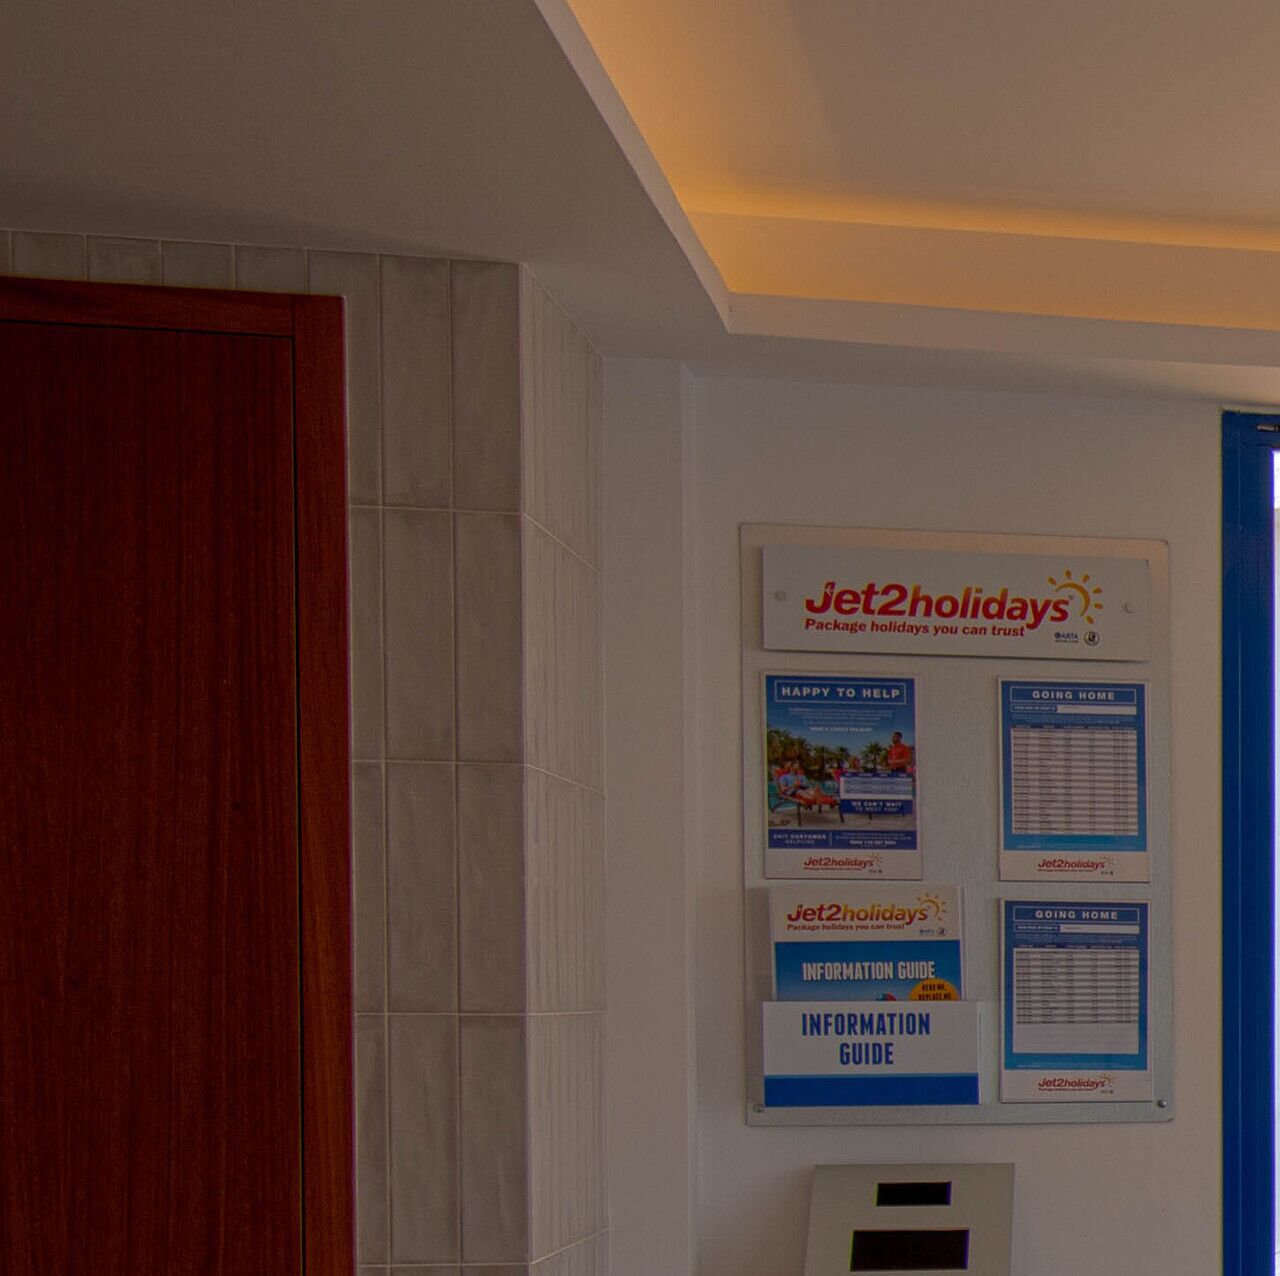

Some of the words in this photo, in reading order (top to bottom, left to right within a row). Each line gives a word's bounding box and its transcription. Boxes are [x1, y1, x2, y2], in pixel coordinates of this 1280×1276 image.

[805, 581, 1070, 629] Jet2holidays
[804, 618, 867, 633] Package
[870, 620, 929, 635] holidays
[933, 624, 958, 636] you
[962, 625, 987, 636] can
[991, 624, 1025, 637] trust
[781, 687, 830, 697] HAPPY
[837, 687, 856, 697] TO
[863, 688, 900, 699] HELP
[1032, 690, 1073, 700] GOING
[1079, 691, 1115, 701] HOME
[804, 857, 874, 869] Jet2holidays
[1038, 859, 1106, 870] Jet2holidays
[787, 903, 928, 925] Jet2holidays
[1035, 910, 1076, 919] GOING
[1082, 911, 1118, 920] HOME
[787, 923, 819, 931] Package
[822, 923, 854, 931] holidays
[802, 961, 893, 981] INFORMATION
[897, 961, 936, 979] GUIDE
[802, 1012, 931, 1036] INFORMATION
[839, 1042, 894, 1065] GUIDE
[1038, 1078, 1105, 1089] Jet2holidays
